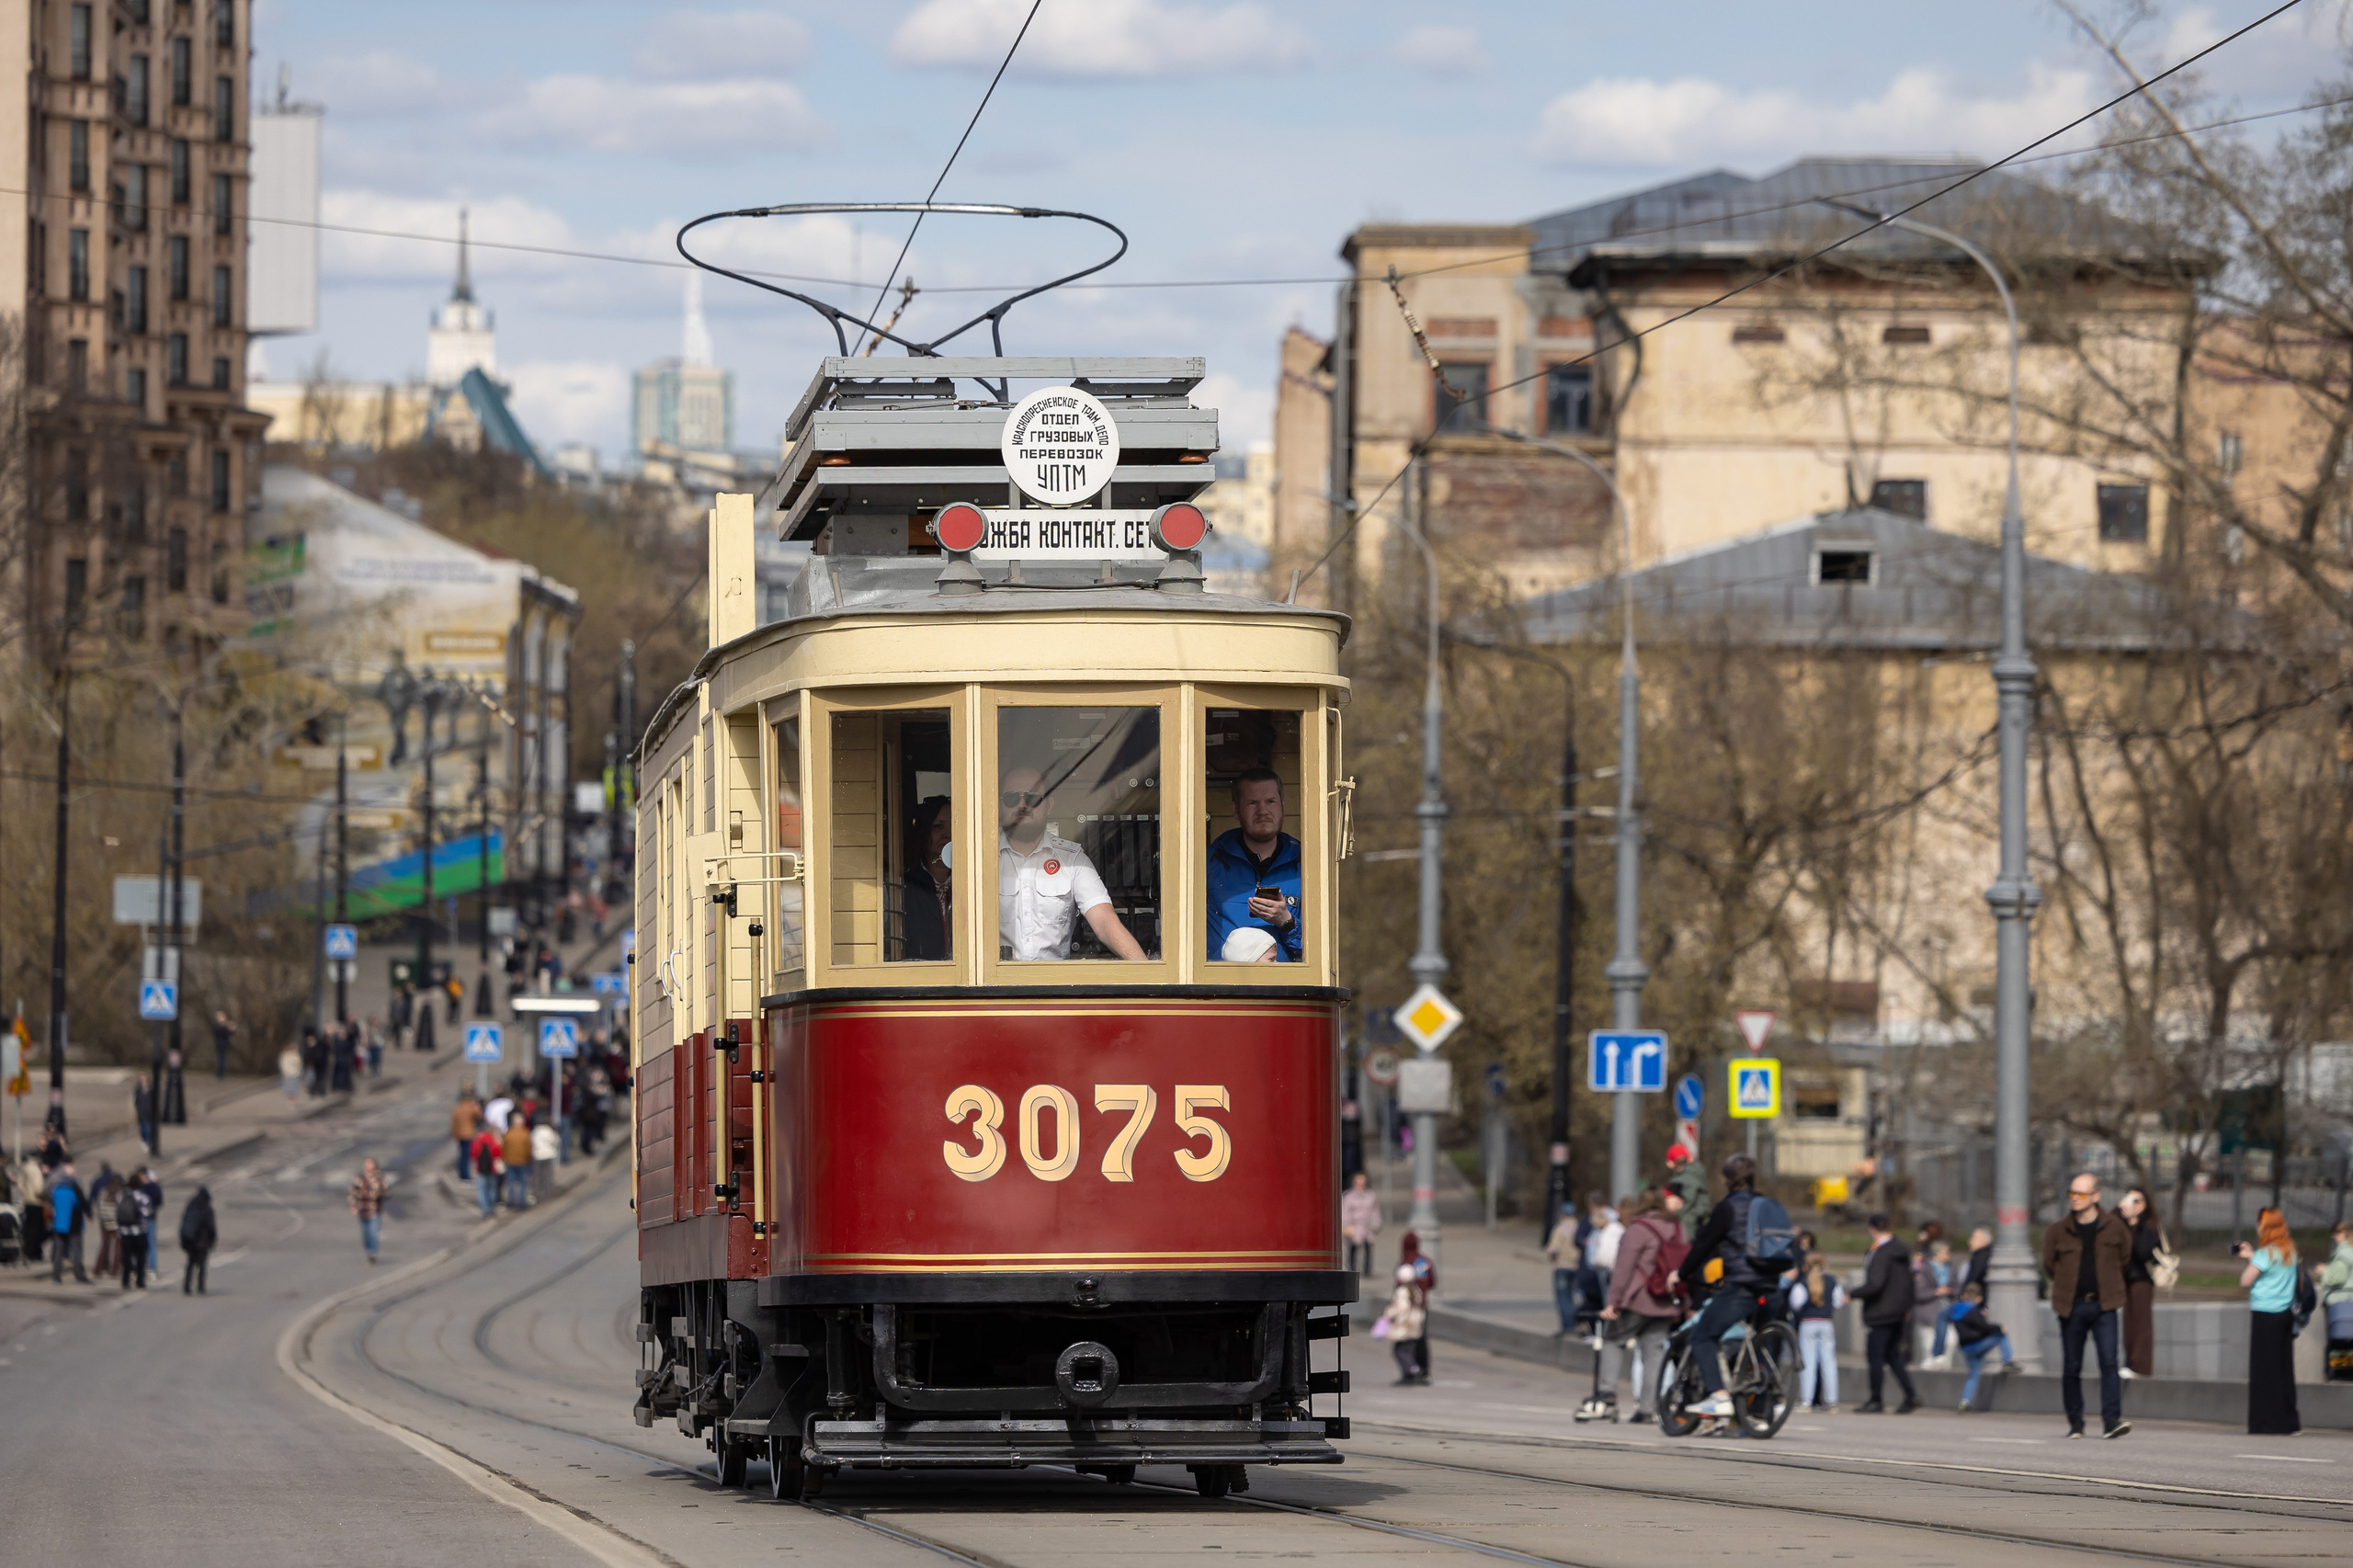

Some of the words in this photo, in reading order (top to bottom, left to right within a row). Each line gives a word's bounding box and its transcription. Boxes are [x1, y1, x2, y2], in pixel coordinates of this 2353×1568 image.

[1012, 396, 1079, 445] КРАСНОПРЕСНЕНСКОЕ
[1081, 403, 1101, 426] ТРАМ.
[1095, 423, 1108, 446] ДЕПО
[1041, 414, 1079, 425] ОТДЕЛ
[1030, 431, 1094, 442] ГРУЗОВЫХ
[1019, 449, 1103, 459] ПЕРЕВОЗОК
[1037, 464, 1086, 492] УПТМ
[1040, 521, 1119, 549] КОНТАКТ.
[943, 1084, 1232, 1183] 3075
